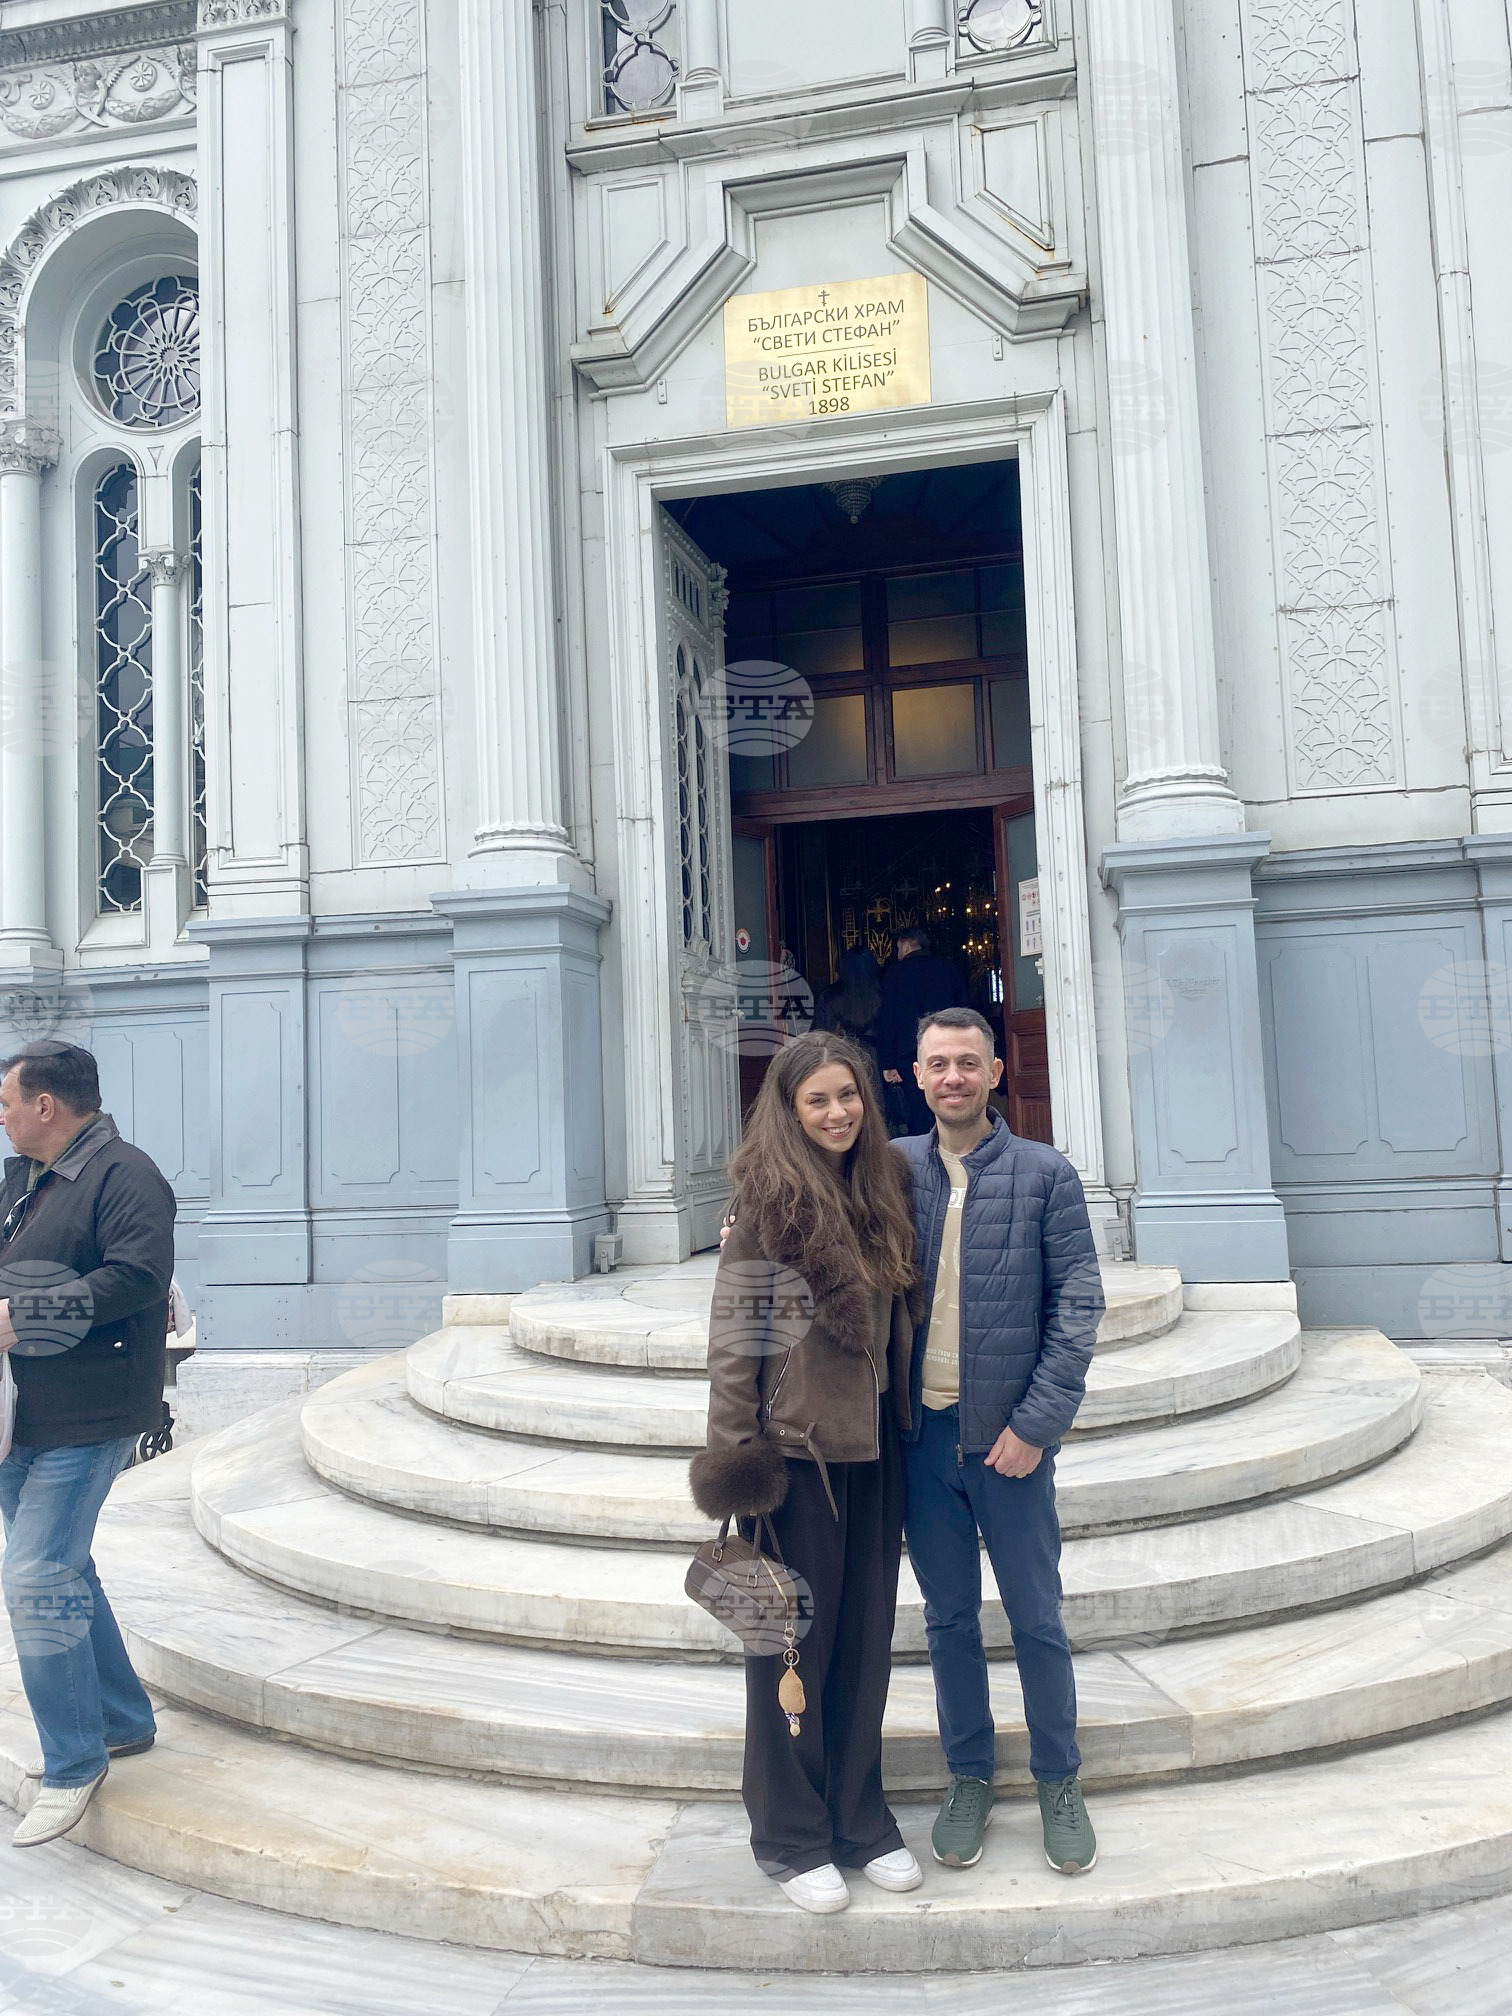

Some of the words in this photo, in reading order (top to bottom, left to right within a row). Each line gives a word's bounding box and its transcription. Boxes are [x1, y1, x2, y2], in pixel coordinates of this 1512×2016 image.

[748, 306, 848, 332] БЪЛГАРСКИ
[854, 299, 904, 319] ХРАМ
[753, 331, 816, 351] “СВЕТИ
[822, 319, 900, 343] СТЕФАН”
[758, 359, 827, 382] BULGAR
[833, 347, 897, 372] KİLİSESİ
[822, 370, 895, 394] STEFAN”
[809, 396, 850, 416] 1898
